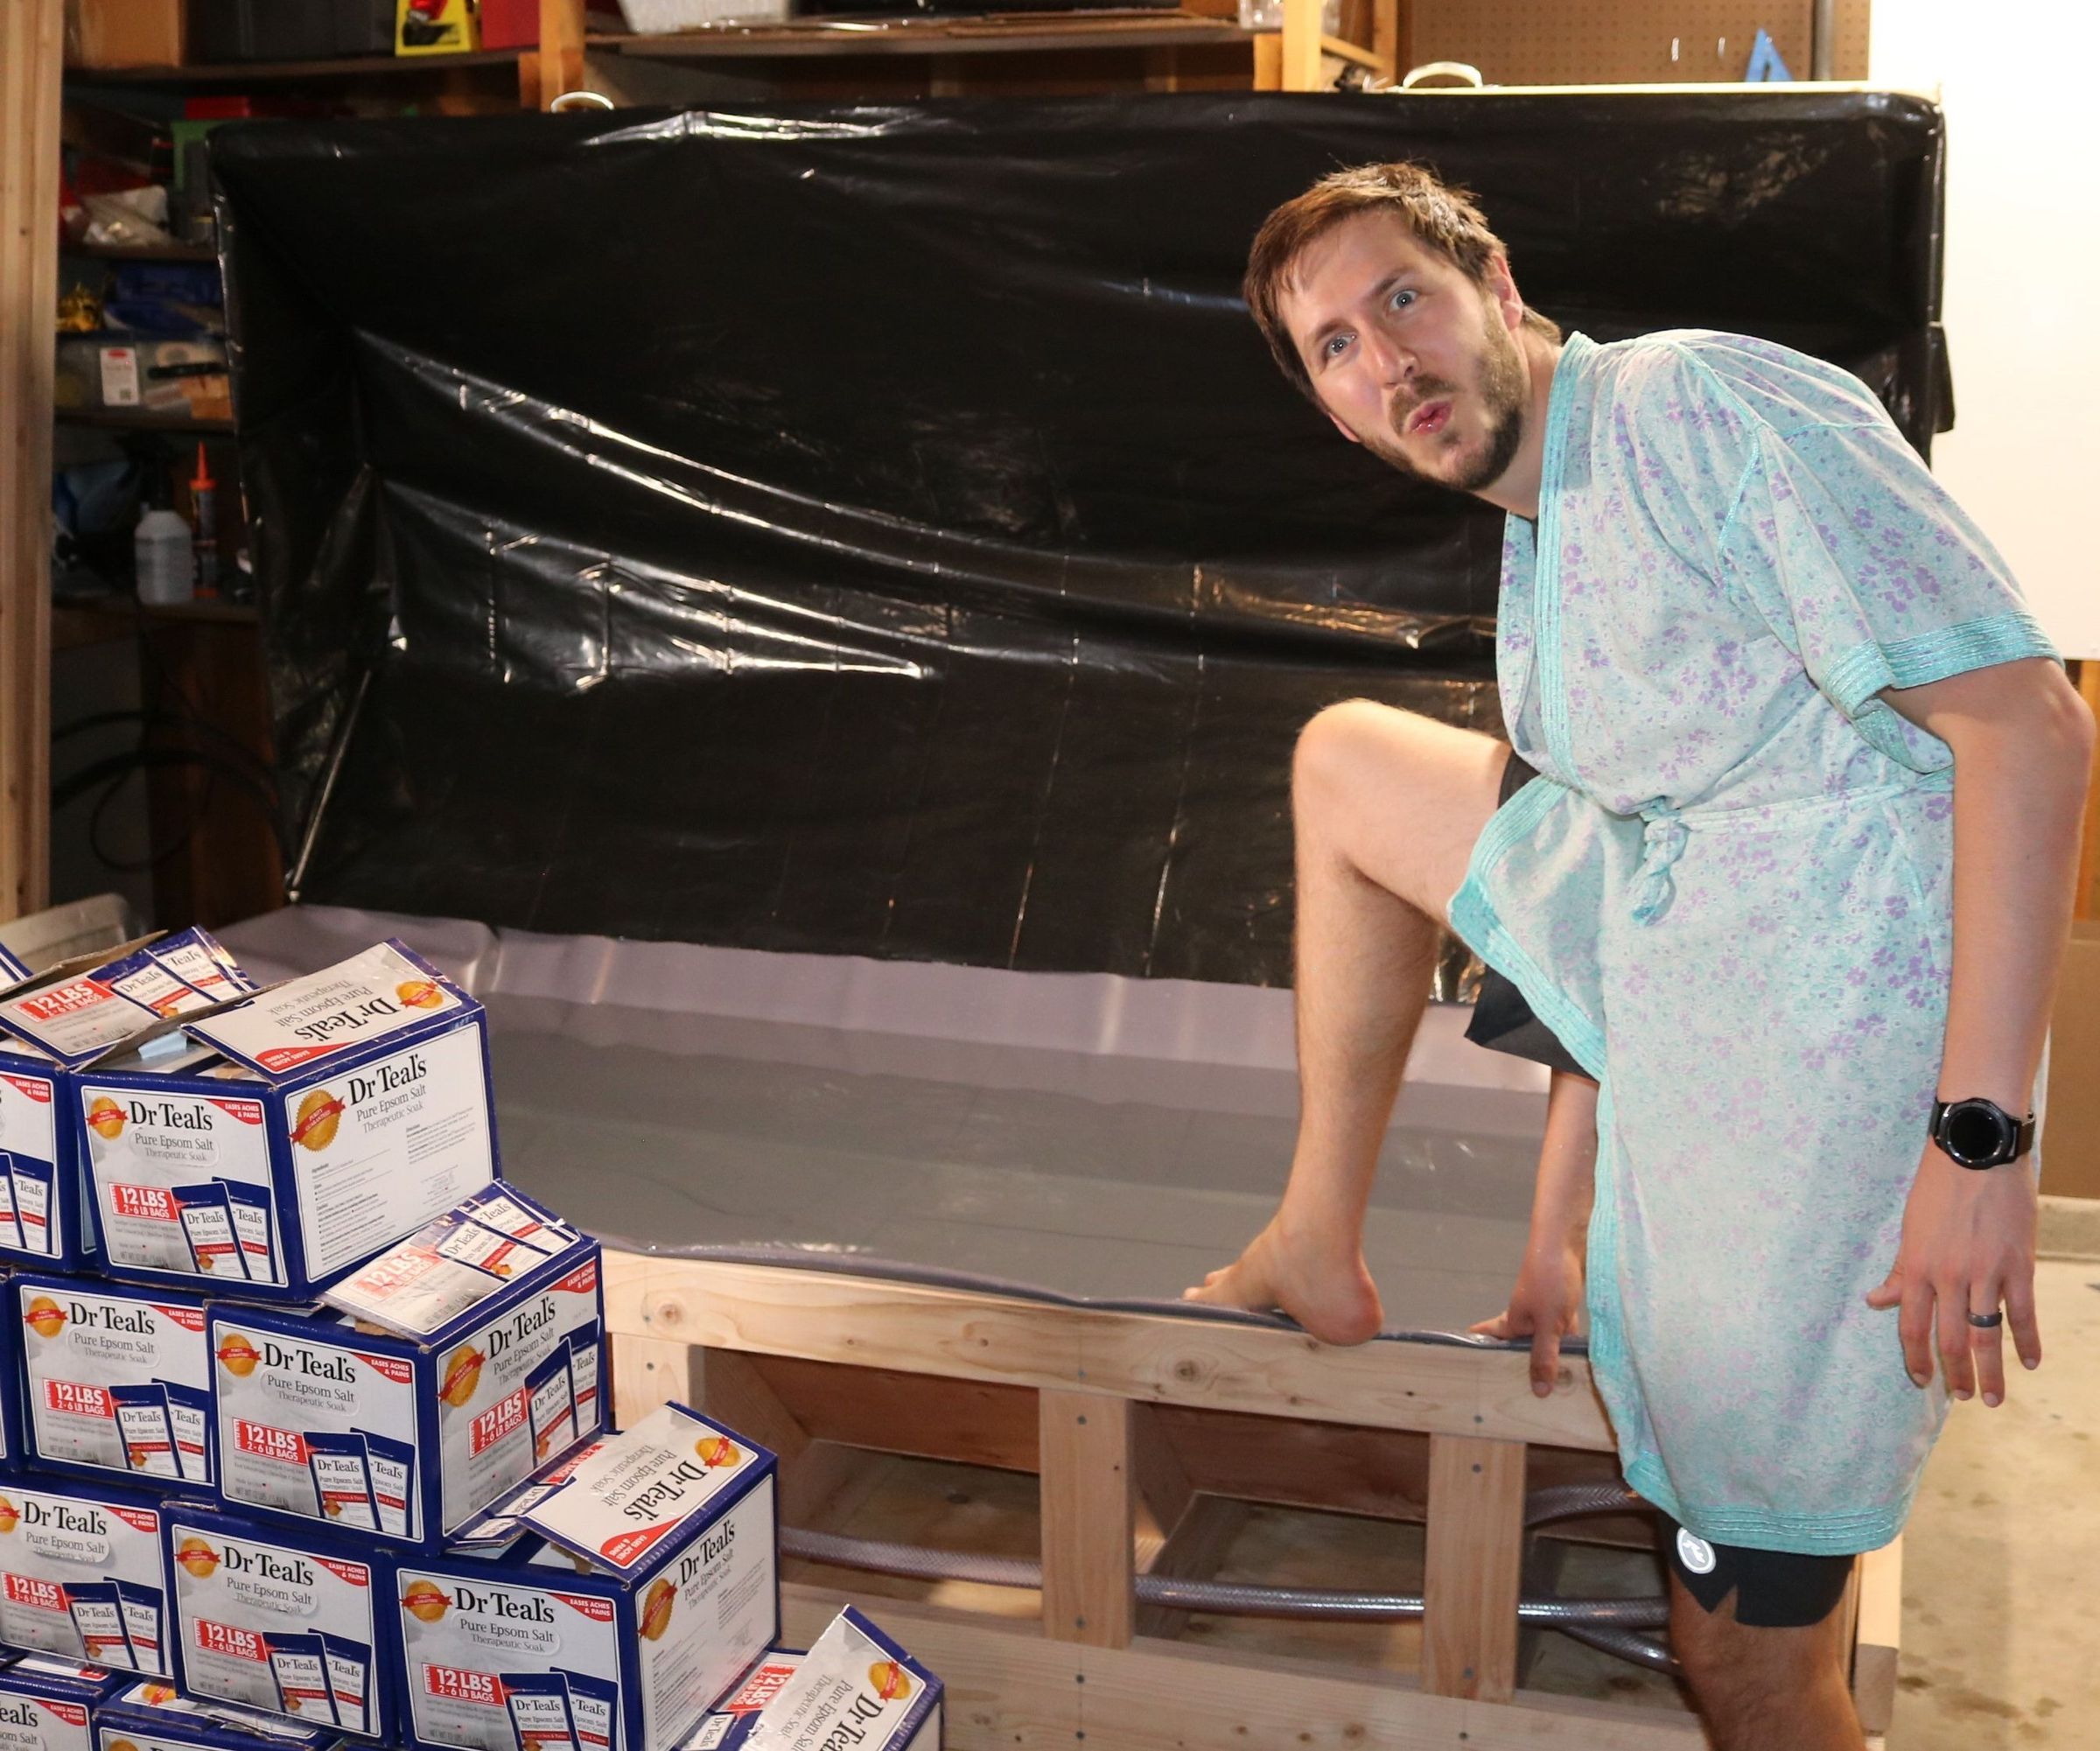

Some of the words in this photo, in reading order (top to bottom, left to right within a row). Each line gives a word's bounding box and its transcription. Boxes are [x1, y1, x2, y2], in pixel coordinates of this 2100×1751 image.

[29, 996, 54, 1011] 12
[53, 981, 94, 1005] LBS
[347, 985, 374, 1003] Pure
[304, 995, 347, 1017] Epsom
[361, 998, 401, 1017] Dr
[276, 1012, 304, 1028] Salt
[294, 1011, 368, 1041] Teal's
[348, 1078, 377, 1106] Dr
[376, 1054, 428, 1093] Teal's
[356, 1106, 378, 1122] Pure
[379, 1094, 410, 1111] Epsom
[410, 1084, 427, 1098] Salt
[129, 1101, 158, 1125] Dr
[158, 1103, 214, 1131] Teal's
[363, 1109, 405, 1134] Therapeutic
[406, 1101, 424, 1114] Soak
[135, 1132, 158, 1146] Pure
[160, 1135, 193, 1151] Epsom
[195, 1138, 214, 1151] Salt
[146, 1147, 187, 1161] Therapeutic
[189, 1151, 207, 1162] Soak
[18, 1180, 44, 1196] Teal's
[120, 1187, 137, 1205] 12
[140, 1190, 167, 1209] LBS
[150, 1208, 170, 1219] BAGS
[187, 1213, 200, 1225] Dr
[200, 1209, 225, 1224] Teal's
[237, 1208, 263, 1225] Teal's
[68, 1302, 98, 1327] Dr
[101, 1306, 156, 1335] Teal's
[168, 1309, 186, 1318] EASES
[186, 1312, 204, 1320] ACHES
[488, 1329, 513, 1360] Dr
[513, 1296, 556, 1341] Teal's
[74, 1333, 98, 1347] Pure
[100, 1336, 134, 1353] Epsom
[136, 1341, 156, 1354] Salt
[493, 1352, 513, 1375] Pure
[514, 1337, 540, 1363] Epsom
[540, 1327, 555, 1345] Salt
[84, 1348, 129, 1363] Therapeutic
[130, 1354, 148, 1365] Soak
[263, 1342, 294, 1370] Dr
[297, 1349, 356, 1383] Teal's
[371, 1359, 388, 1368] EASES
[389, 1362, 410, 1371] ACHES
[390, 1369, 410, 1378] PAINS
[55, 1383, 74, 1400] 12
[75, 1386, 104, 1406] LBS
[267, 1375, 292, 1390] Pure
[296, 1380, 332, 1398] Epsom
[334, 1389, 354, 1403] Salt
[534, 1396, 546, 1411] Dr
[545, 1376, 567, 1402] Teal's
[74, 1404, 83, 1412] LB
[84, 1404, 106, 1416] BAGS
[278, 1390, 325, 1409] Therapeutic
[326, 1400, 346, 1412] Soak
[122, 1411, 136, 1423] Dr
[136, 1410, 162, 1422] Teal's
[175, 1410, 201, 1425] Teal's
[480, 1410, 498, 1432] 12
[497, 1392, 523, 1419] LBS
[495, 1424, 505, 1438] LB
[504, 1413, 523, 1432] BAGS
[246, 1424, 265, 1445] 12
[267, 1429, 298, 1451] LBS
[265, 1446, 275, 1456] LB
[276, 1448, 298, 1461] BAGS
[652, 1448, 677, 1468] Pure
[318, 1459, 332, 1471] Dr
[332, 1460, 360, 1473] Teal's
[374, 1461, 403, 1479] Teal's
[668, 1460, 707, 1485] Dr
[623, 1465, 657, 1490] Epsom
[602, 1488, 627, 1506] Salt
[623, 1481, 685, 1521] Teal's
[24, 1501, 52, 1526] Dr
[53, 1506, 107, 1536] Teal's
[26, 1531, 48, 1545] Pure
[51, 1535, 84, 1552] Epsom
[87, 1541, 105, 1555] Salt
[680, 1556, 700, 1586] Dr
[700, 1519, 736, 1566] Teal's
[223, 1545, 254, 1573] Dr
[255, 1553, 314, 1586] Teal's
[328, 1562, 346, 1571] EASES
[346, 1566, 366, 1575] ACHES
[12, 1576, 30, 1594] 12
[31, 1580, 58, 1600] LBS
[227, 1577, 251, 1593] Pure
[254, 1582, 289, 1601] Epsom
[291, 1592, 312, 1606] Salt
[30, 1596, 38, 1606] LB
[39, 1598, 60, 1610] BAGS
[77, 1607, 90, 1618] Dr
[91, 1607, 116, 1619] Teal's
[454, 1586, 488, 1614] Dr
[490, 1592, 556, 1623] Teal's
[570, 1599, 589, 1607] EASES
[590, 1601, 610, 1610] ACHES
[129, 1606, 154, 1622] Teal's
[206, 1623, 225, 1642] 12
[228, 1628, 256, 1649] LBS
[460, 1619, 486, 1634] Pure
[491, 1623, 528, 1641] Epsom
[532, 1629, 554, 1642] Salt
[226, 1644, 235, 1654] LB
[236, 1647, 258, 1659] BAGS
[472, 1634, 521, 1651] Therapeutic
[524, 1642, 545, 1653] Soak
[276, 1657, 291, 1669] Dr
[291, 1658, 318, 1671] Teal's
[332, 1659, 360, 1678] Teal's
[437, 1668, 458, 1689] 12
[459, 1673, 494, 1694] LBS
[763, 1670, 791, 1686] 12
[458, 1689, 468, 1698] LB
[471, 1691, 494, 1703] BAGS
[745, 1685, 778, 1705] LBS
[795, 1674, 835, 1720] Therapeutic
[833, 1679, 854, 1703] Pure
[515, 1699, 530, 1712] Dr
[530, 1699, 561, 1712] Teal's
[575, 1698, 606, 1716] Teal's
[847, 1692, 884, 1726] Dr
[778, 1719, 799, 1740] Soak
[804, 1702, 838, 1736] Epsom
[19, 1732, 38, 1746] Salt
